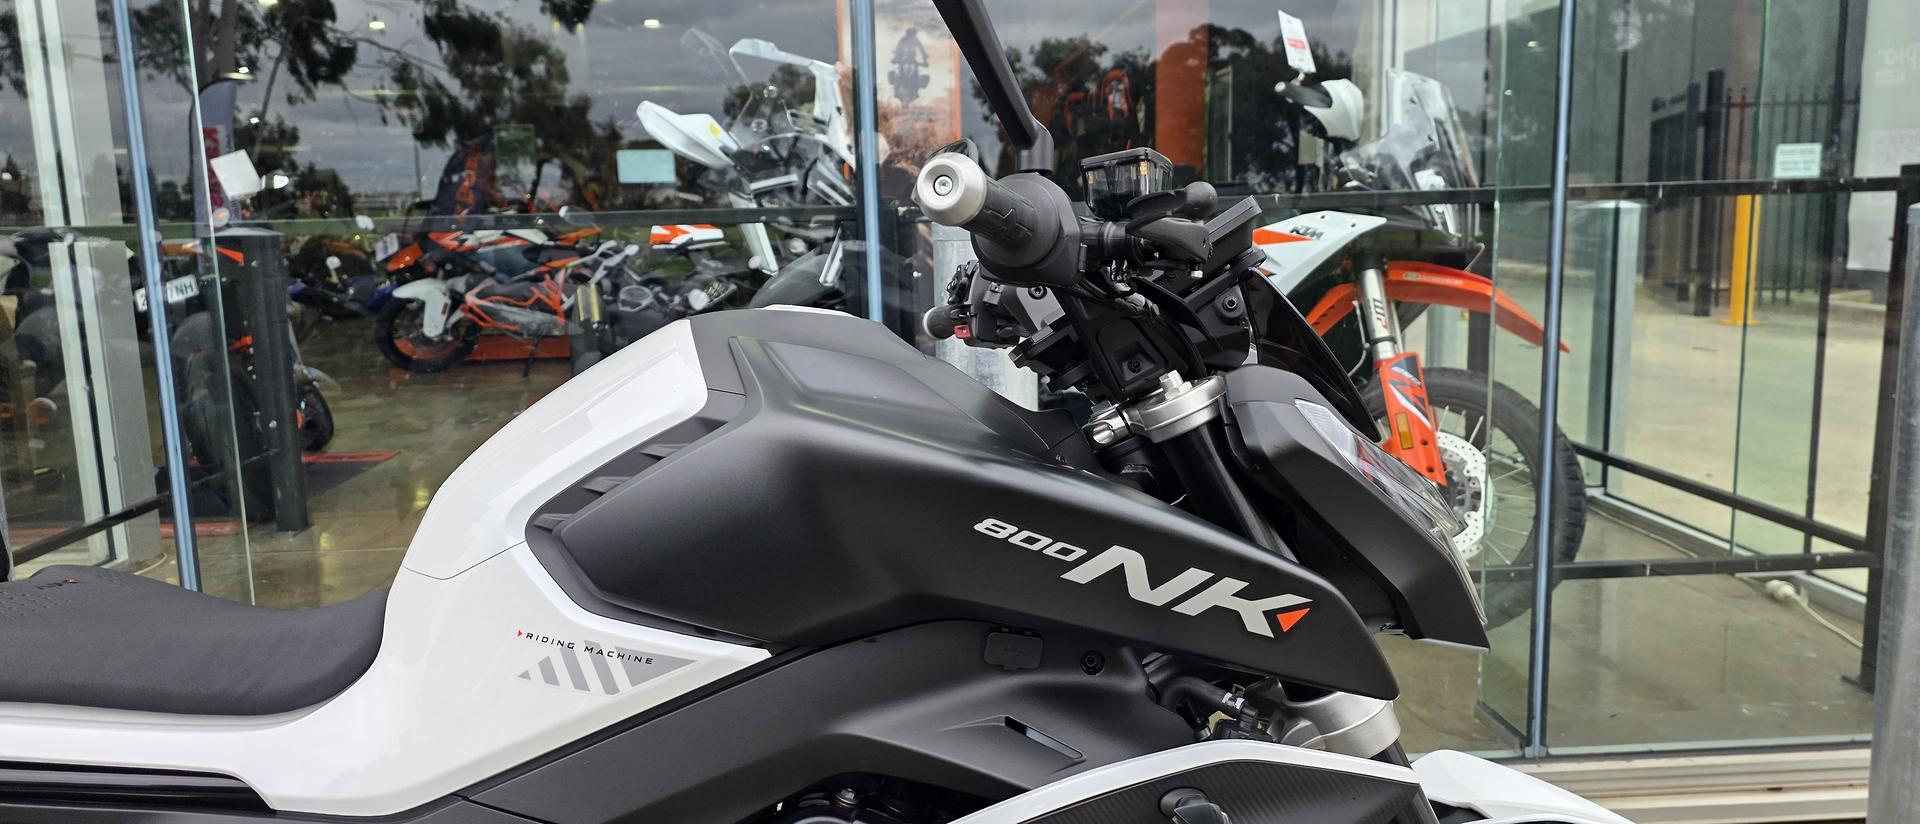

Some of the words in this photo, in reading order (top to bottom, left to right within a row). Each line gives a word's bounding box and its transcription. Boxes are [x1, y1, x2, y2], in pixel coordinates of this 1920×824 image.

[1289, 225, 1324, 239] KTM
[973, 517, 1088, 562] 800
[1059, 544, 1314, 639] NK
[525, 632, 575, 650] RIDING
[583, 645, 654, 665] MACHINE
